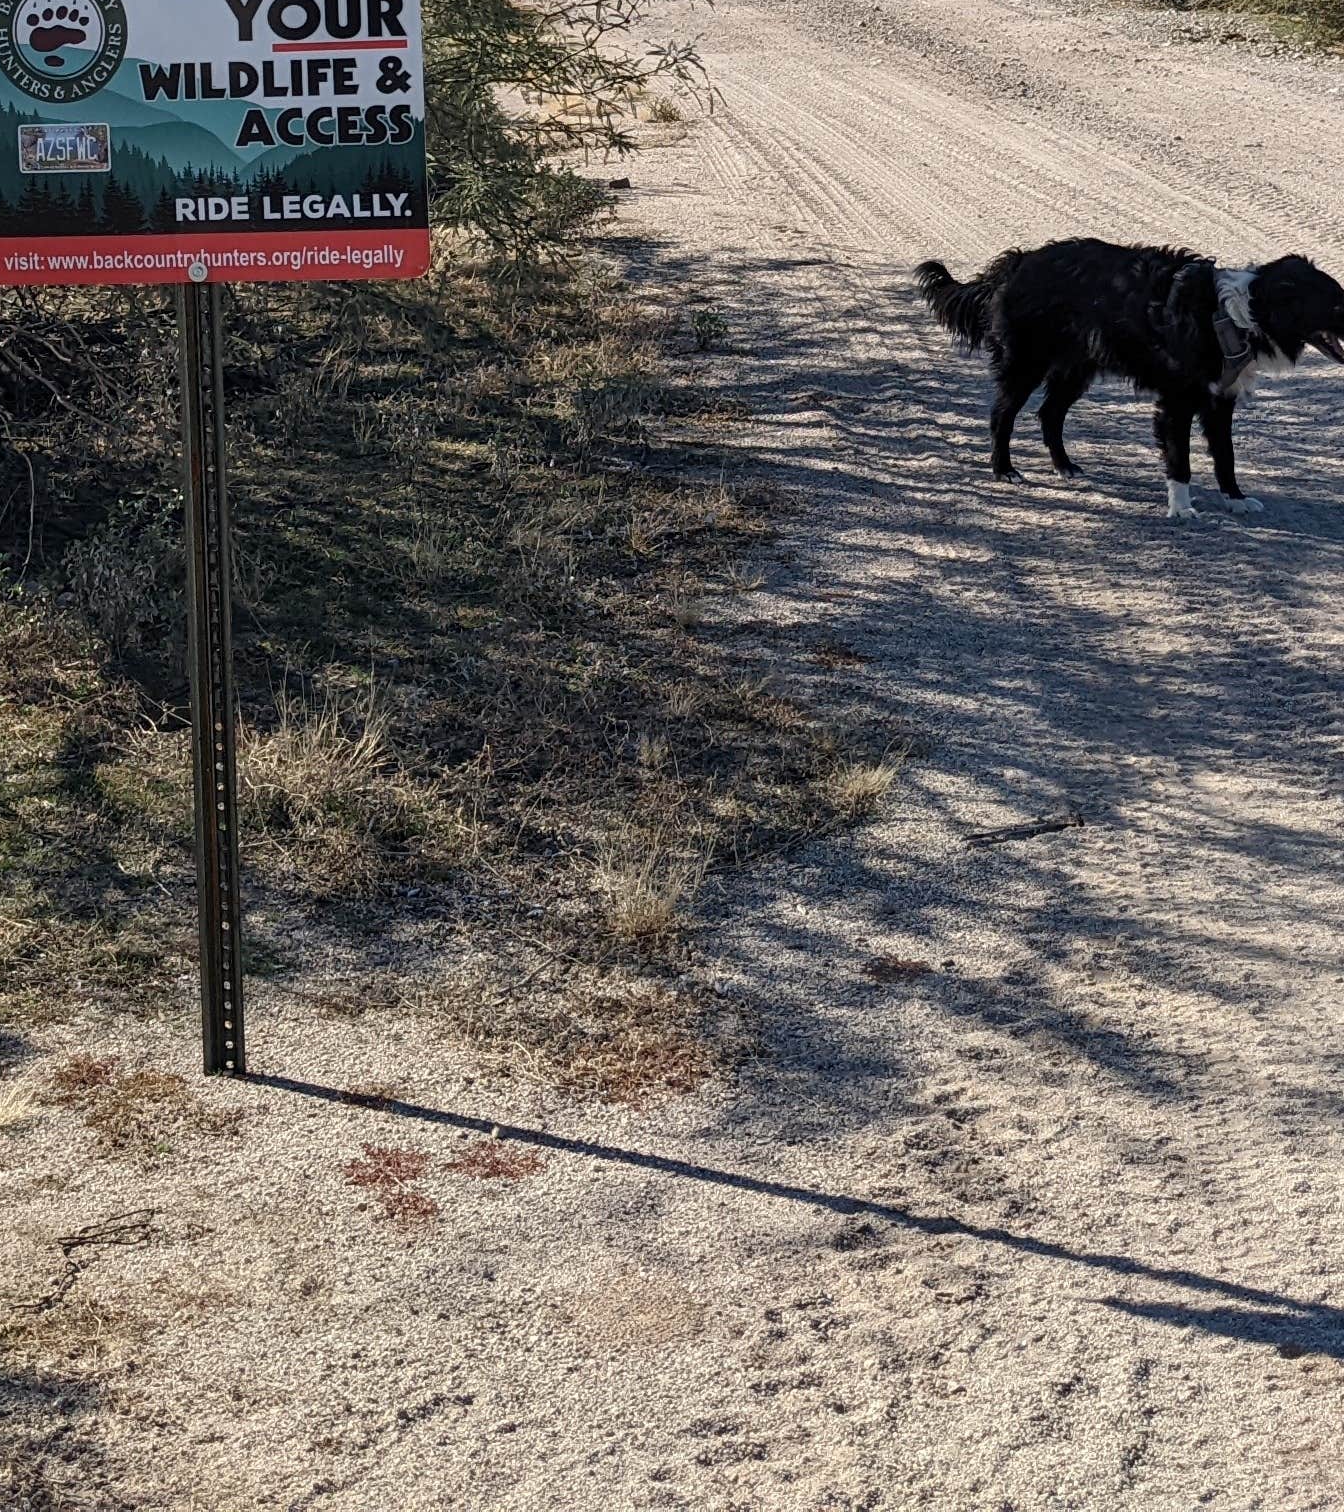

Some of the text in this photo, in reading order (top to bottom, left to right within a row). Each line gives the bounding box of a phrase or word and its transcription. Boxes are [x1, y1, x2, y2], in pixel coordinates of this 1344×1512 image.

[54, 86, 65, 99] &
[71, 23, 122, 98] ANGLERS
[138, 55, 412, 101] WILDLIFE &
[235, 104, 414, 147] ACCESS
[36, 136, 98, 162] AZSFWC
[175, 193, 413, 222] RIDE LEGALLY.
[4, 252, 45, 270] visit:
